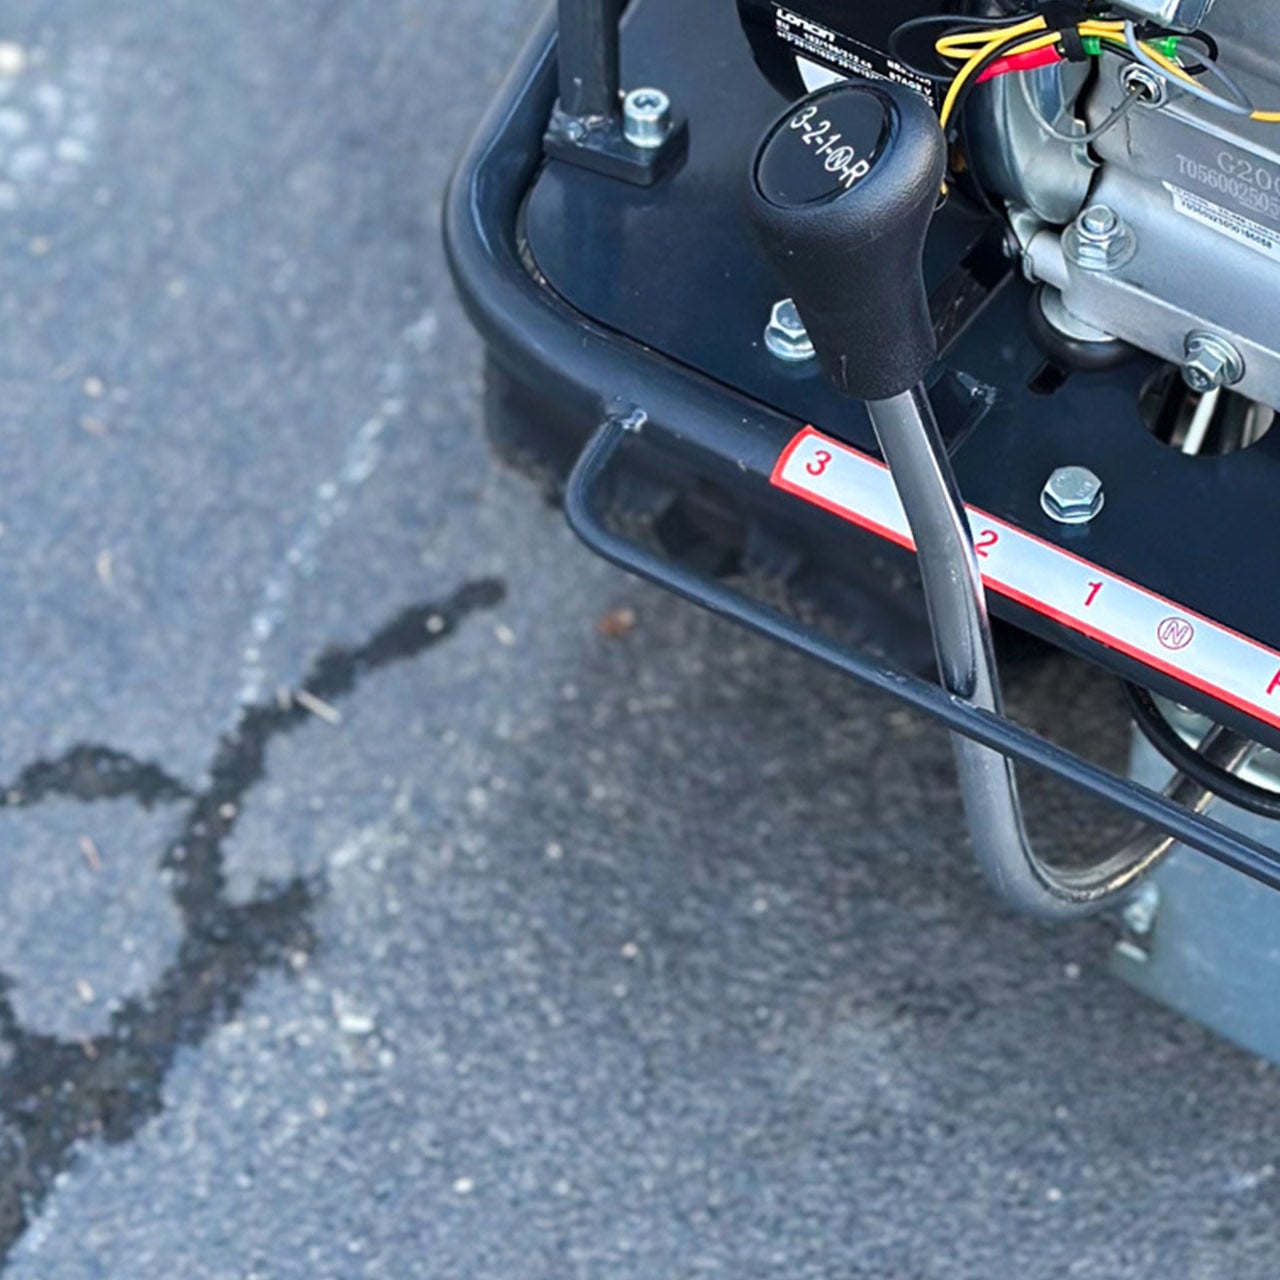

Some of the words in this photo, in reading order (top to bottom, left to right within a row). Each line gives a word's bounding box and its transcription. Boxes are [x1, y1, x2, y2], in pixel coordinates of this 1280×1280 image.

[805, 449, 832, 477] 3
[974, 529, 999, 558] 2
[1082, 581, 1103, 607] 1
